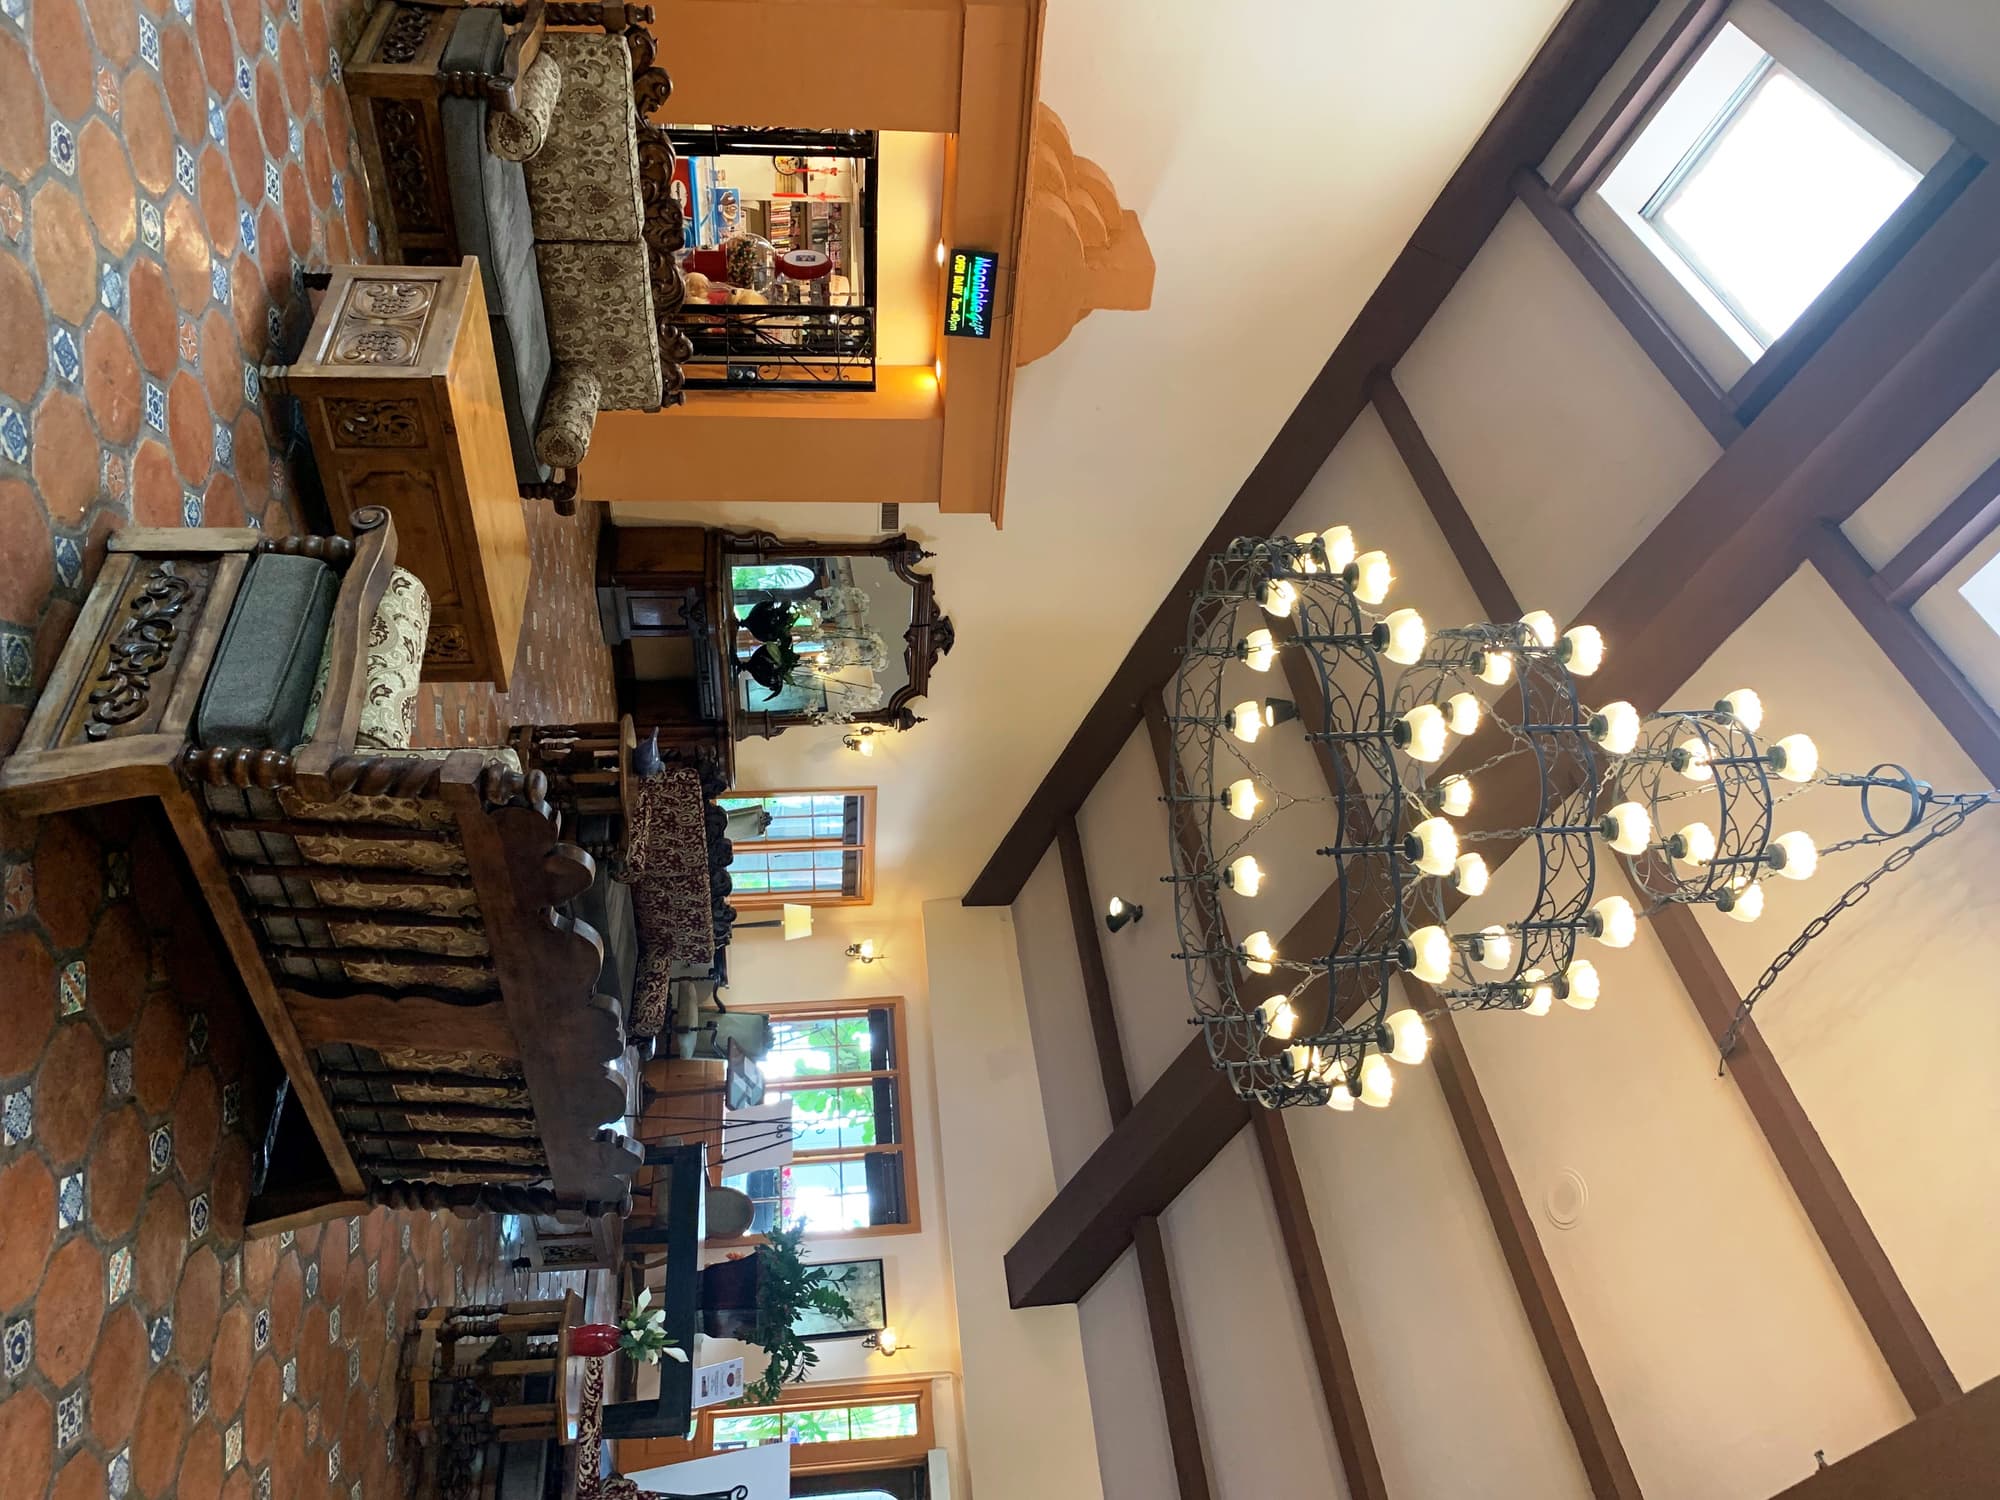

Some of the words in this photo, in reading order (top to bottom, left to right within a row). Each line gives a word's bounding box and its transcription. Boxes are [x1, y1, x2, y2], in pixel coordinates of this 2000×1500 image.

[954, 254, 966, 274] OPEN
[952, 275, 964, 295] DAILY
[970, 257, 992, 312] Moonlake
[948, 297, 962, 331] 7am-10pm
[966, 313, 984, 336] Gifts
